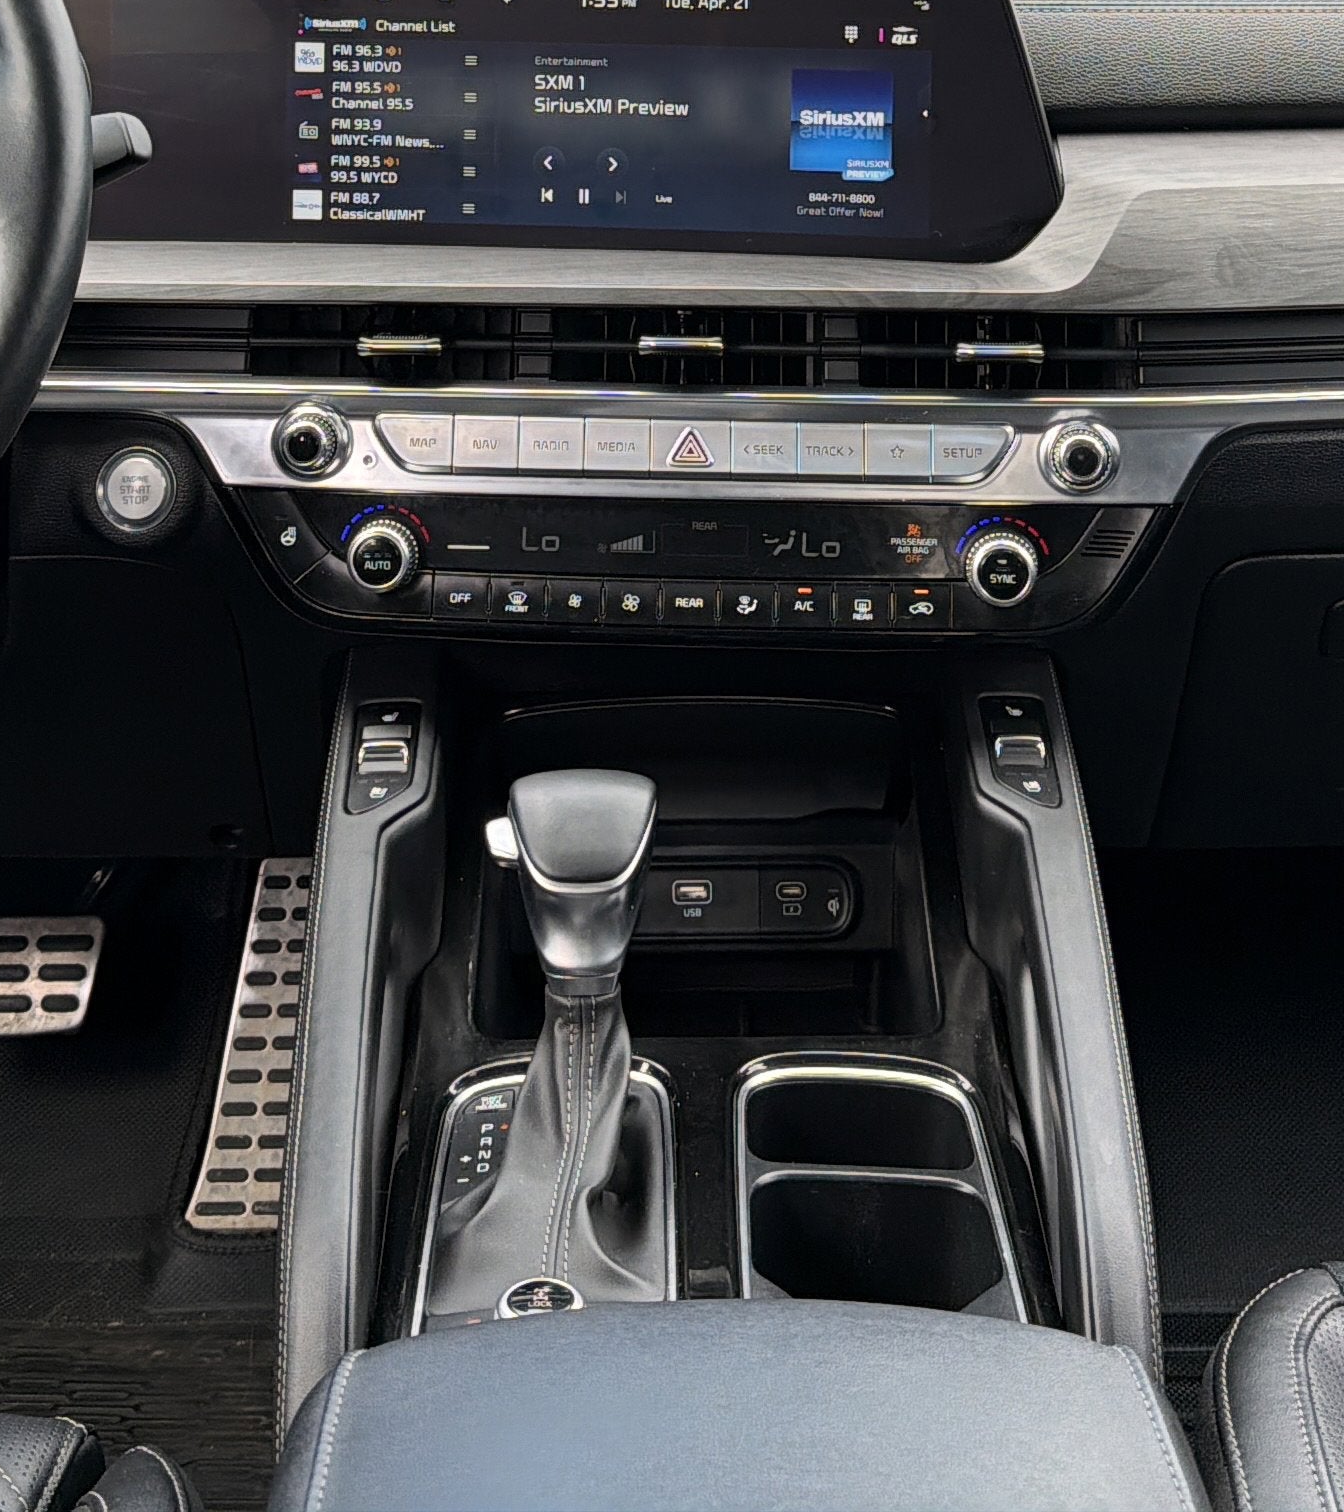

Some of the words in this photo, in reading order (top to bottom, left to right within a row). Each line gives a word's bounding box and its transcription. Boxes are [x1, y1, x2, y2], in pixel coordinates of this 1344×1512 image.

[375, 19, 428, 33] Channel
[430, 20, 456, 33] List
[891, 34, 918, 45] QLS
[332, 44, 352, 56] FM
[355, 44, 383, 57] 96.3
[332, 60, 360, 73] 96.3
[363, 60, 402, 73] WDVD
[534, 55, 609, 67] Entertainment
[332, 81, 352, 93] FM
[354, 81, 382, 94] 95.5
[534, 74, 574, 91] SXM
[578, 75, 585, 91] 1
[331, 96, 384, 109] Channel
[386, 97, 414, 111] 95.5
[534, 96, 613, 115] SiriusXM
[617, 98, 689, 117] Preview
[799, 109, 885, 127] SiriusXM
[331, 118, 351, 130] FM
[353, 118, 382, 131] 93.9
[330, 134, 393, 147] WNYC-FM
[330, 155, 351, 167] FM
[353, 155, 381, 168] 99.5
[330, 170, 358, 183] 99.5
[360, 171, 398, 184] WYCD
[846, 169, 889, 178] PREVIEW
[330, 191, 350, 204] FM
[352, 192, 381, 205] 88.7
[655, 193, 673, 204] Live
[796, 205, 826, 216] Great
[828, 205, 857, 217] Offer
[859, 206, 885, 218] Now!
[408, 436, 437, 449] MAP
[471, 438, 499, 451] NAV
[532, 440, 570, 452] RADIO
[597, 441, 637, 454] MEDIA
[752, 444, 784, 456] SEEK
[805, 445, 845, 457] TRACK
[942, 446, 983, 460] SETUP
[119, 485, 152, 495] START
[122, 495, 149, 505] STOP
[692, 521, 718, 531] REAR
[889, 536, 938, 547] PASSENGER
[896, 546, 912, 555] AIR
[913, 546, 930, 555] BAG
[904, 554, 923, 563] OFF
[363, 559, 392, 571] AUTO
[989, 573, 1017, 585] SYNC
[449, 592, 472, 604] OFF
[675, 597, 704, 609] REAR
[504, 603, 529, 613] FRONT
[794, 599, 815, 613] A/C
[852, 612, 874, 621] REAR
[683, 907, 702, 918] USB
[480, 1122, 494, 1134] P
[479, 1135, 492, 1147] R
[477, 1148, 492, 1160] N
[476, 1161, 490, 1173] D
[527, 1299, 553, 1308] LOCK
